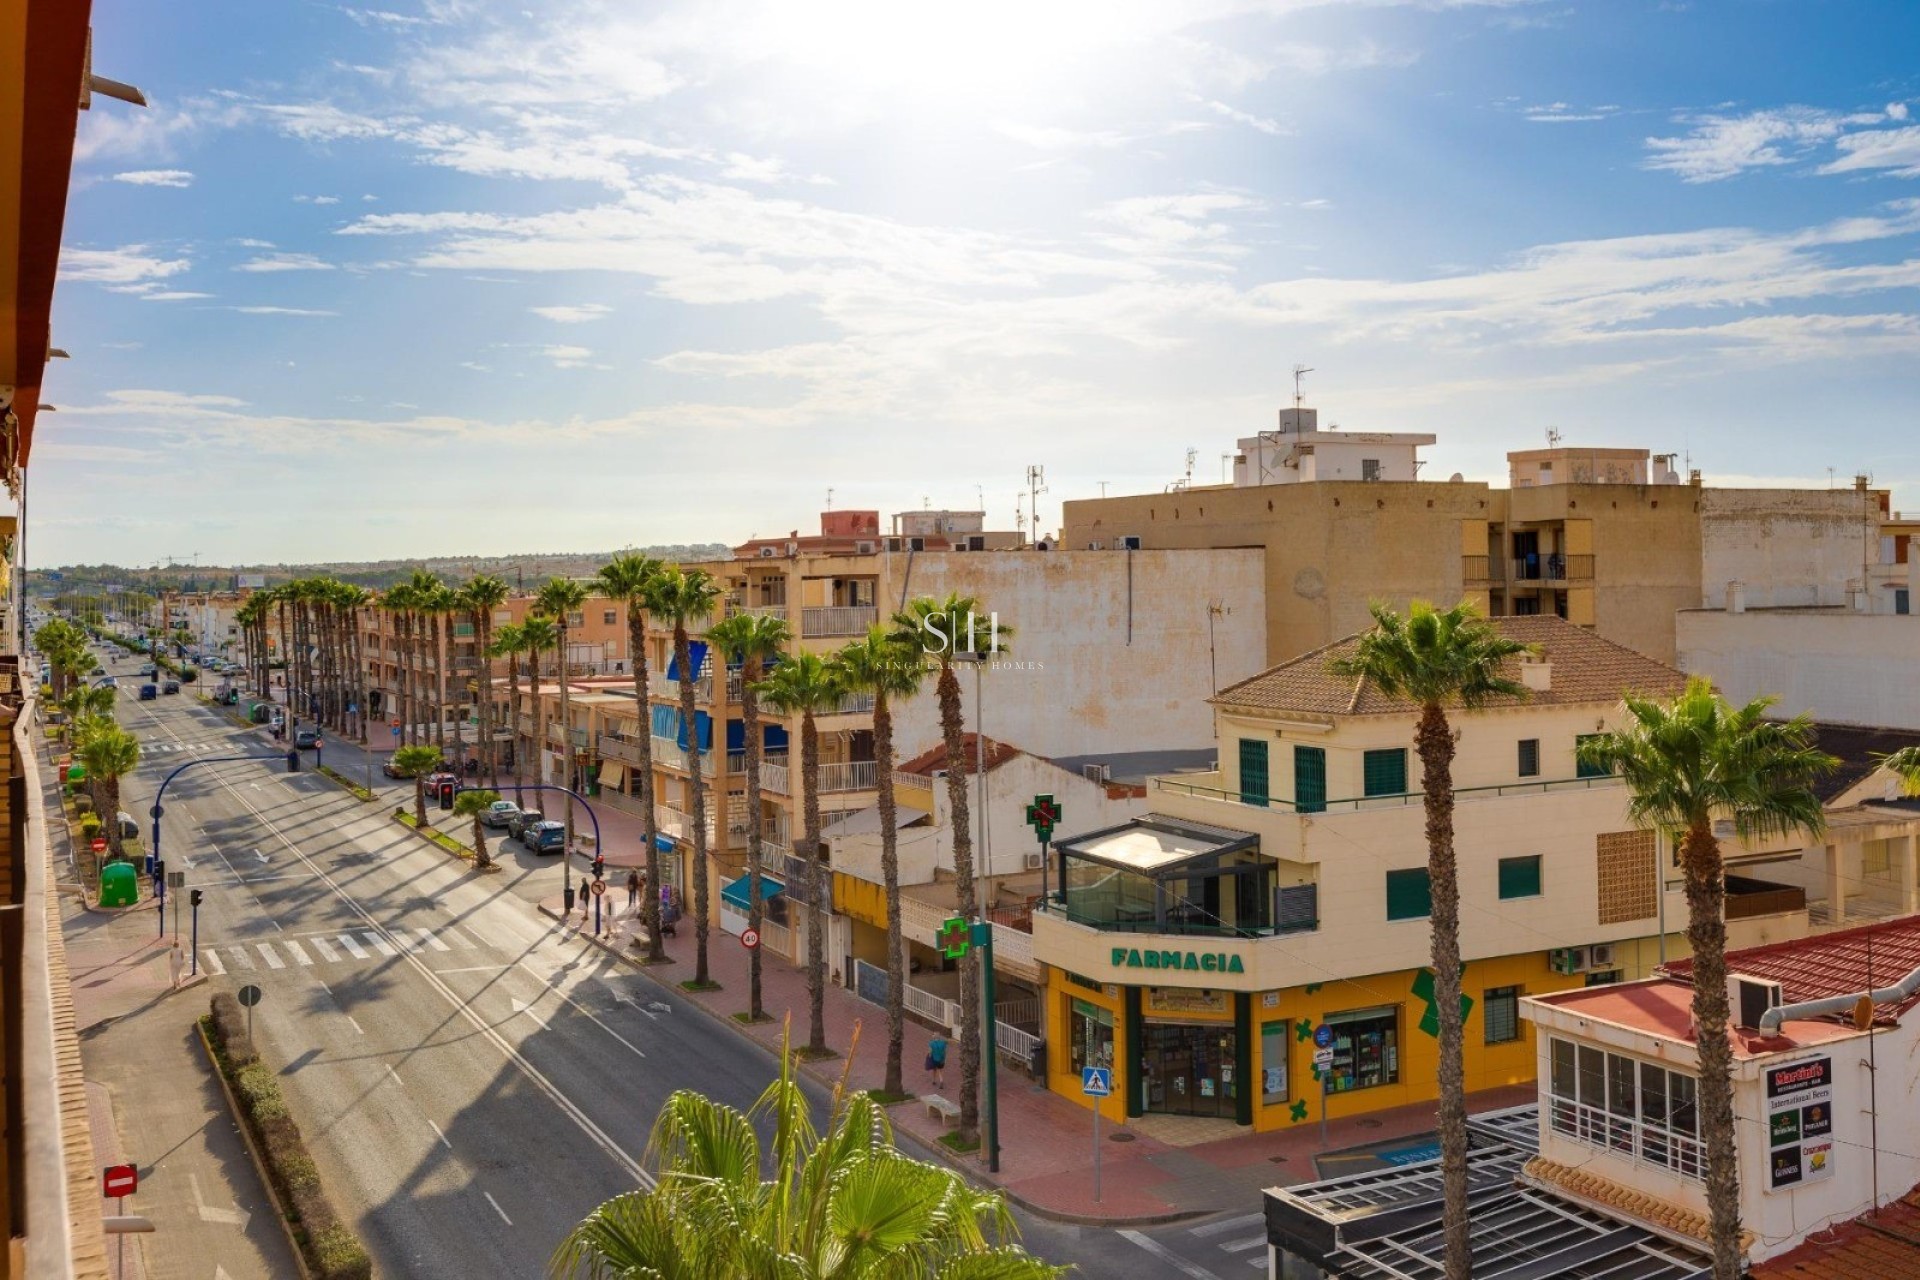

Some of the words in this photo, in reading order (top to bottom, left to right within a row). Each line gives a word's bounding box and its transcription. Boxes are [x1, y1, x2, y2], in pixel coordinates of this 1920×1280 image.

[1111, 947, 1245, 973] FARMACIA
[1770, 1093, 1810, 1108] International
[1812, 1090, 1829, 1099] Beers
